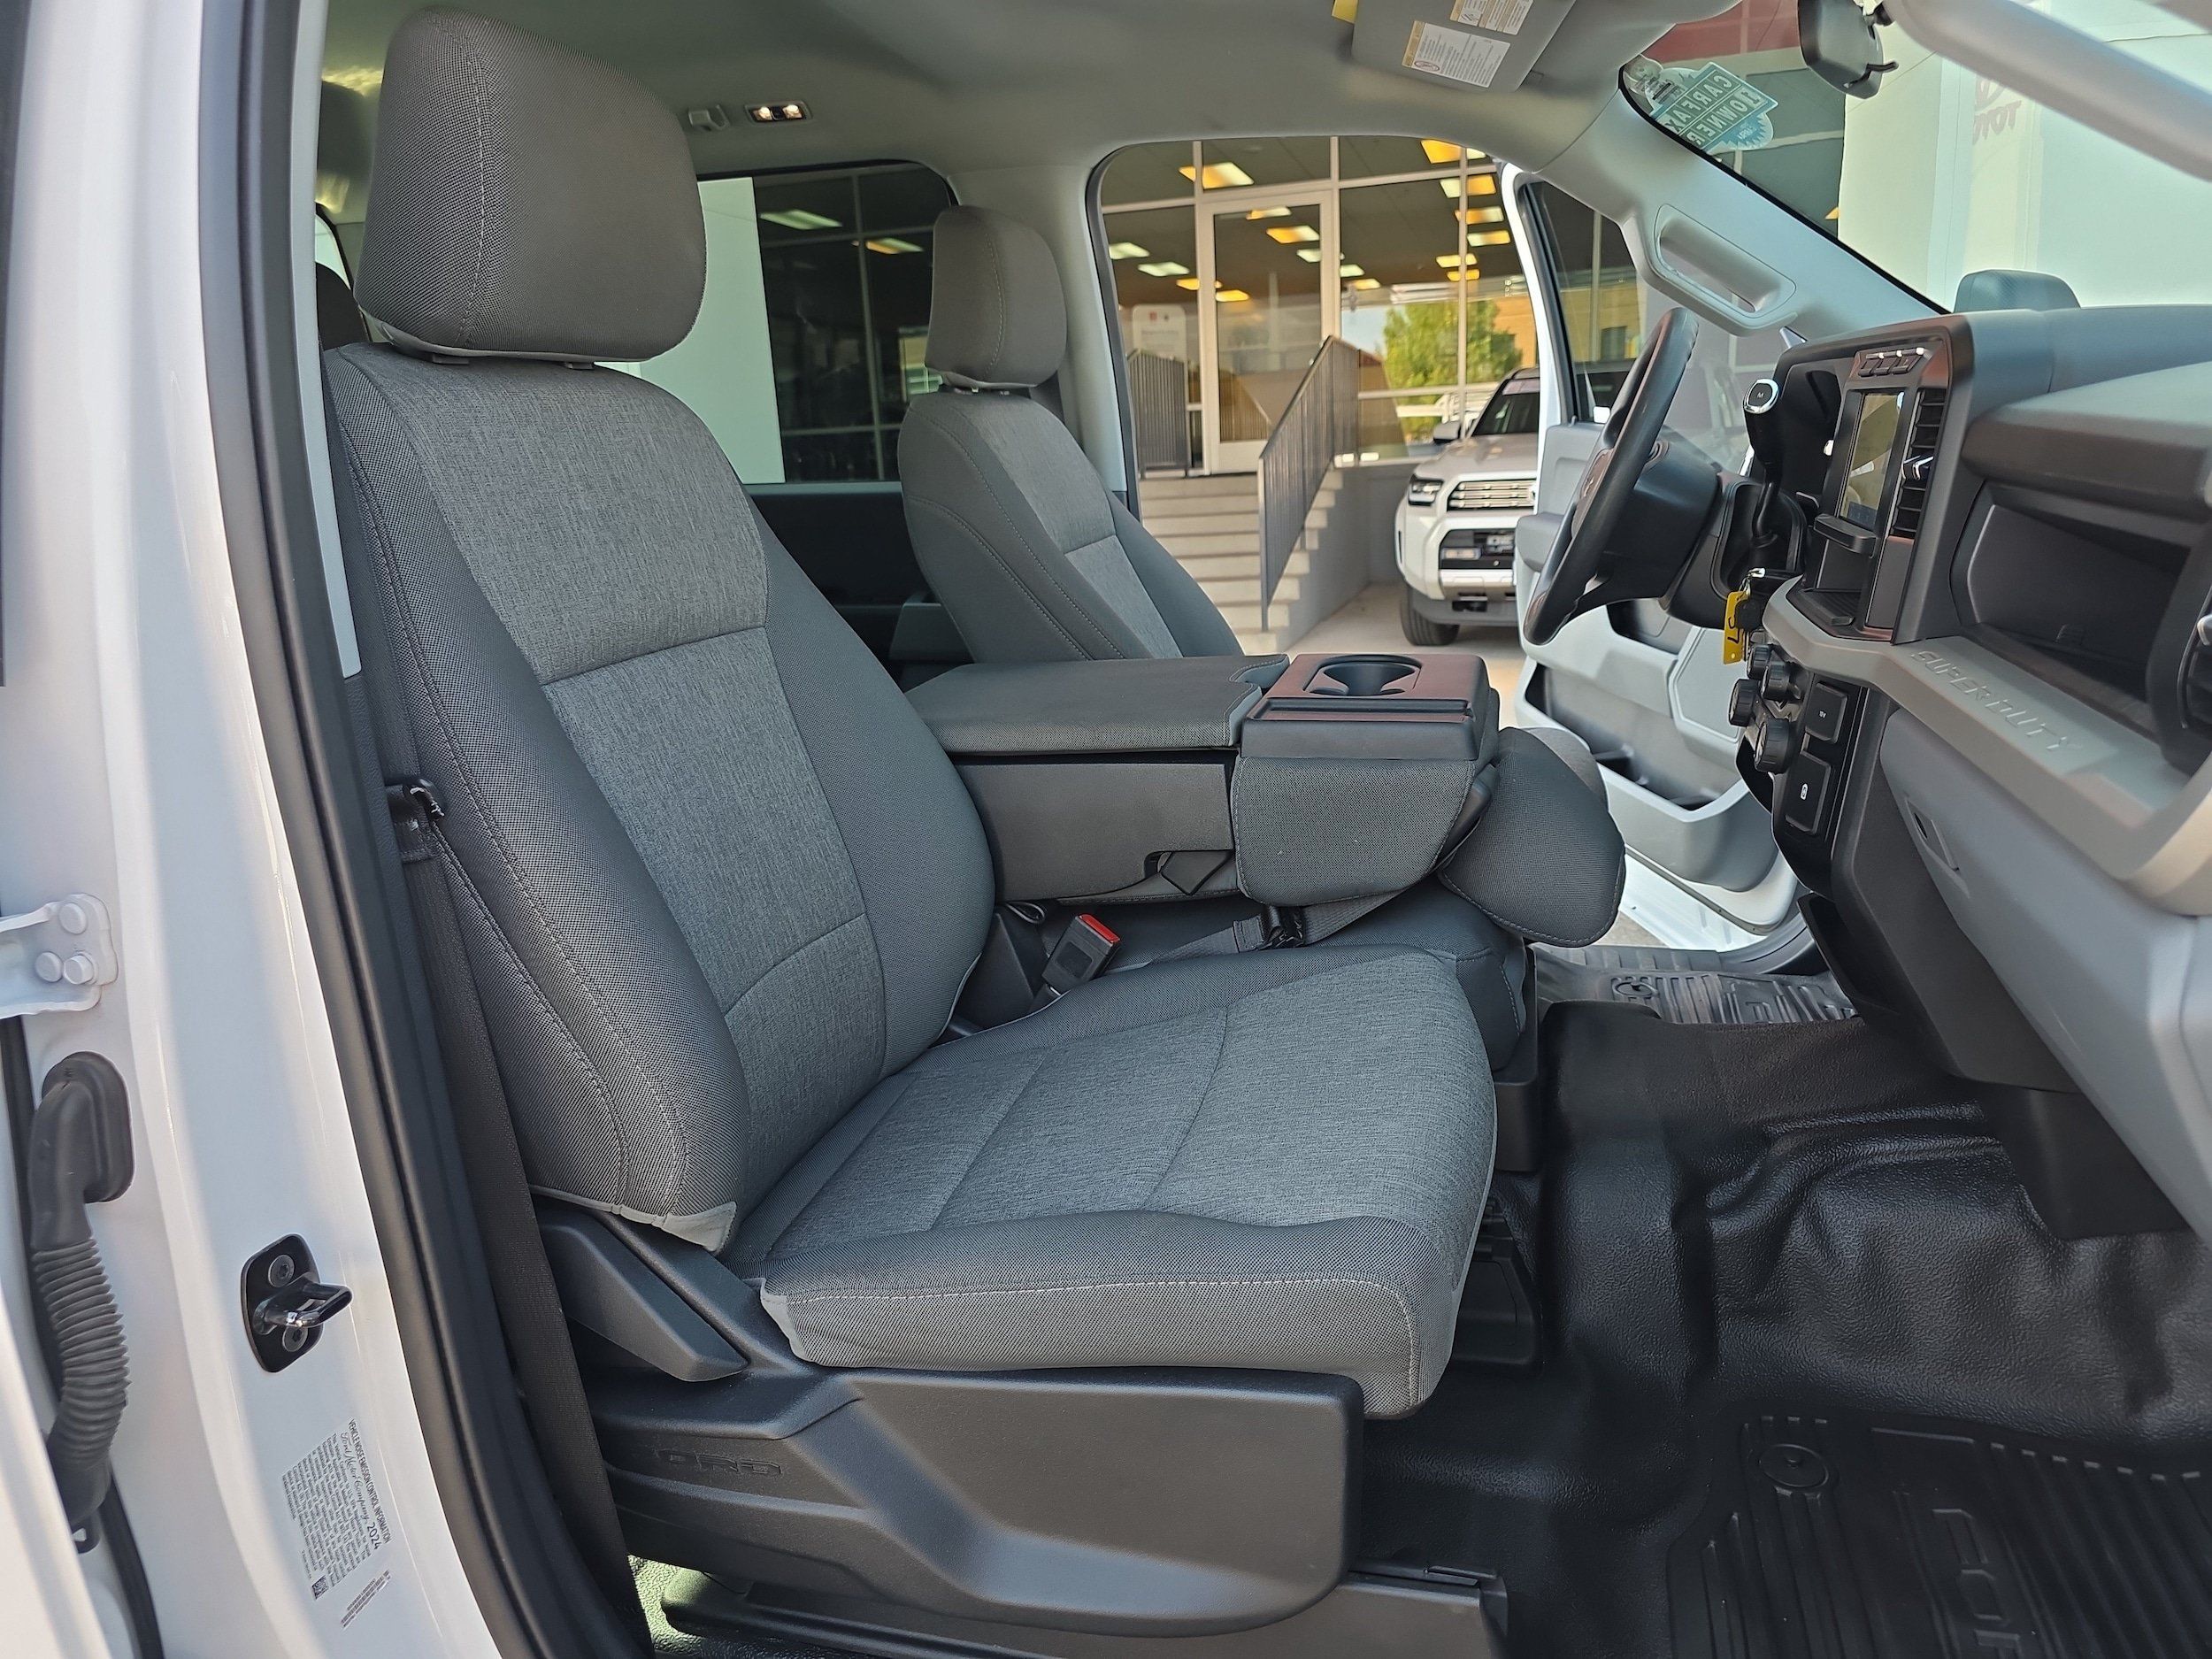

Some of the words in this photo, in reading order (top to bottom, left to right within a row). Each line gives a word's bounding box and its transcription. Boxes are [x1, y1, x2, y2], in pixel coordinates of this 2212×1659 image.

[1910, 650, 1991, 701] SUPER
[1985, 699, 2069, 751] DUTY
[349, 1419, 358, 1442] VEHICLE
[355, 1440, 365, 1458] NOISE
[359, 1456, 372, 1483] EMISSION
[341, 1431, 353, 1455] Ford
[367, 1522, 381, 1550] 2024
[367, 1480, 380, 1507] CONTROL
[374, 1506, 391, 1543] INFORMATION
